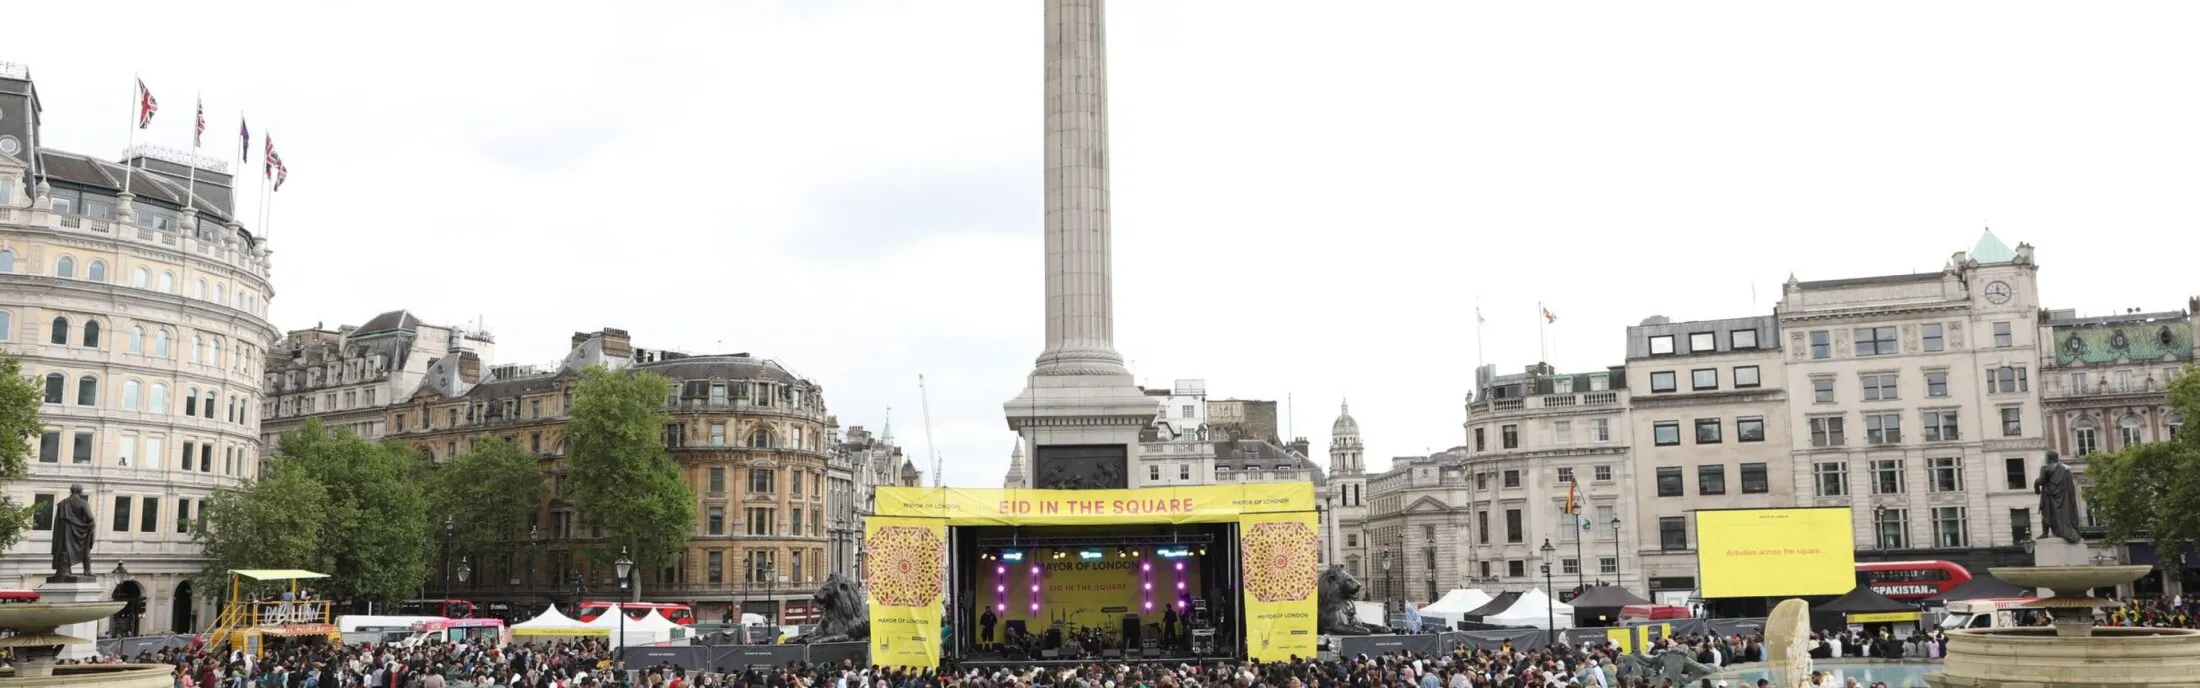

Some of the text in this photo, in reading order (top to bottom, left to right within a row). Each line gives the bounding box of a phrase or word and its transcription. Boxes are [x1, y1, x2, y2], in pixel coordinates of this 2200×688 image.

[999, 498, 1193, 515] EID IN THE SQUARE
[1039, 560, 1139, 572] MAYOR OF LONDON
[1049, 584, 1063, 592] EID
[1095, 583, 1127, 592] SQUARE
